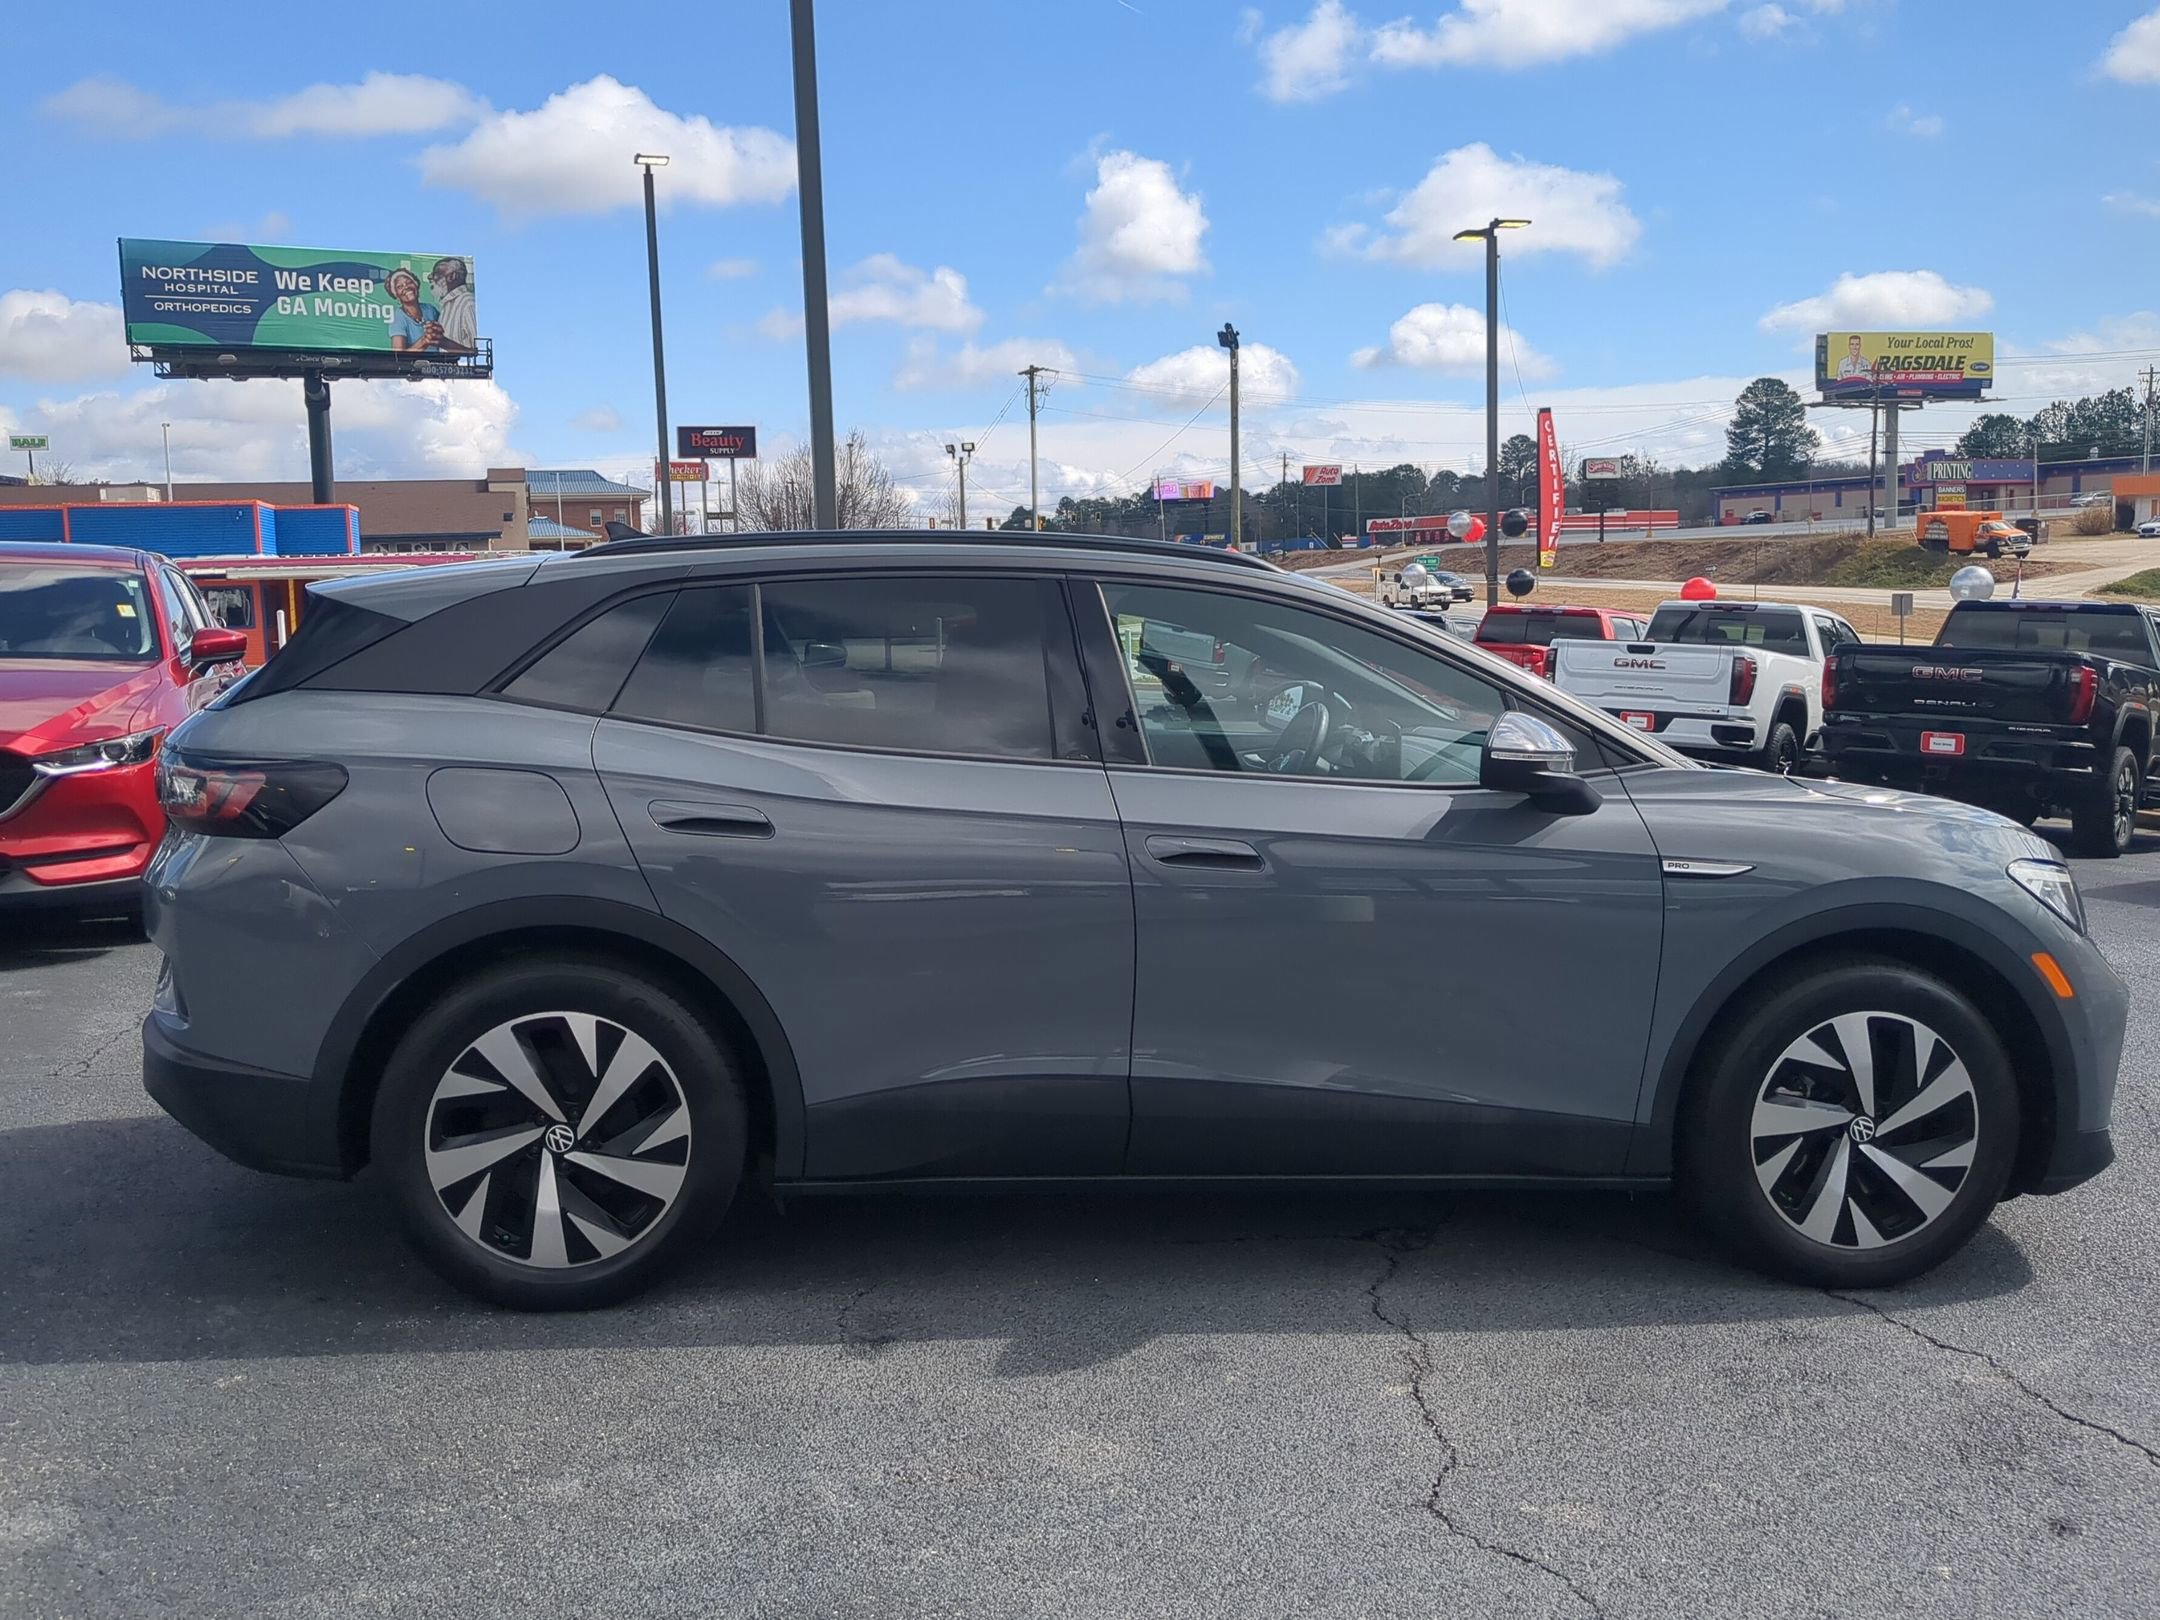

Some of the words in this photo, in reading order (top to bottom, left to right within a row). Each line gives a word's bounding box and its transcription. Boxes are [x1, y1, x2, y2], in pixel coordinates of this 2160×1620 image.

[141, 266, 260, 284] NORTHSIDE
[164, 283, 239, 295] HOSPITAL
[273, 271, 312, 291] We
[318, 273, 375, 297] Keep
[153, 301, 252, 315] ORTHOPEDICS
[276, 297, 308, 316] GA
[314, 298, 395, 323] Moving
[1887, 336, 1914, 349] Your
[1916, 336, 1945, 349] Local
[1946, 336, 1975, 349] Pros!
[1877, 355, 1967, 371] RAGSDALE
[691, 433, 744, 451] Beauty
[1319, 466, 1339, 475] Auto
[1933, 462, 1971, 480] PRINTING
[1315, 475, 1336, 484] Zone
[1614, 657, 1666, 670] GMC
[1911, 665, 1984, 682] GMC
[1913, 699, 1977, 708] DENALI
